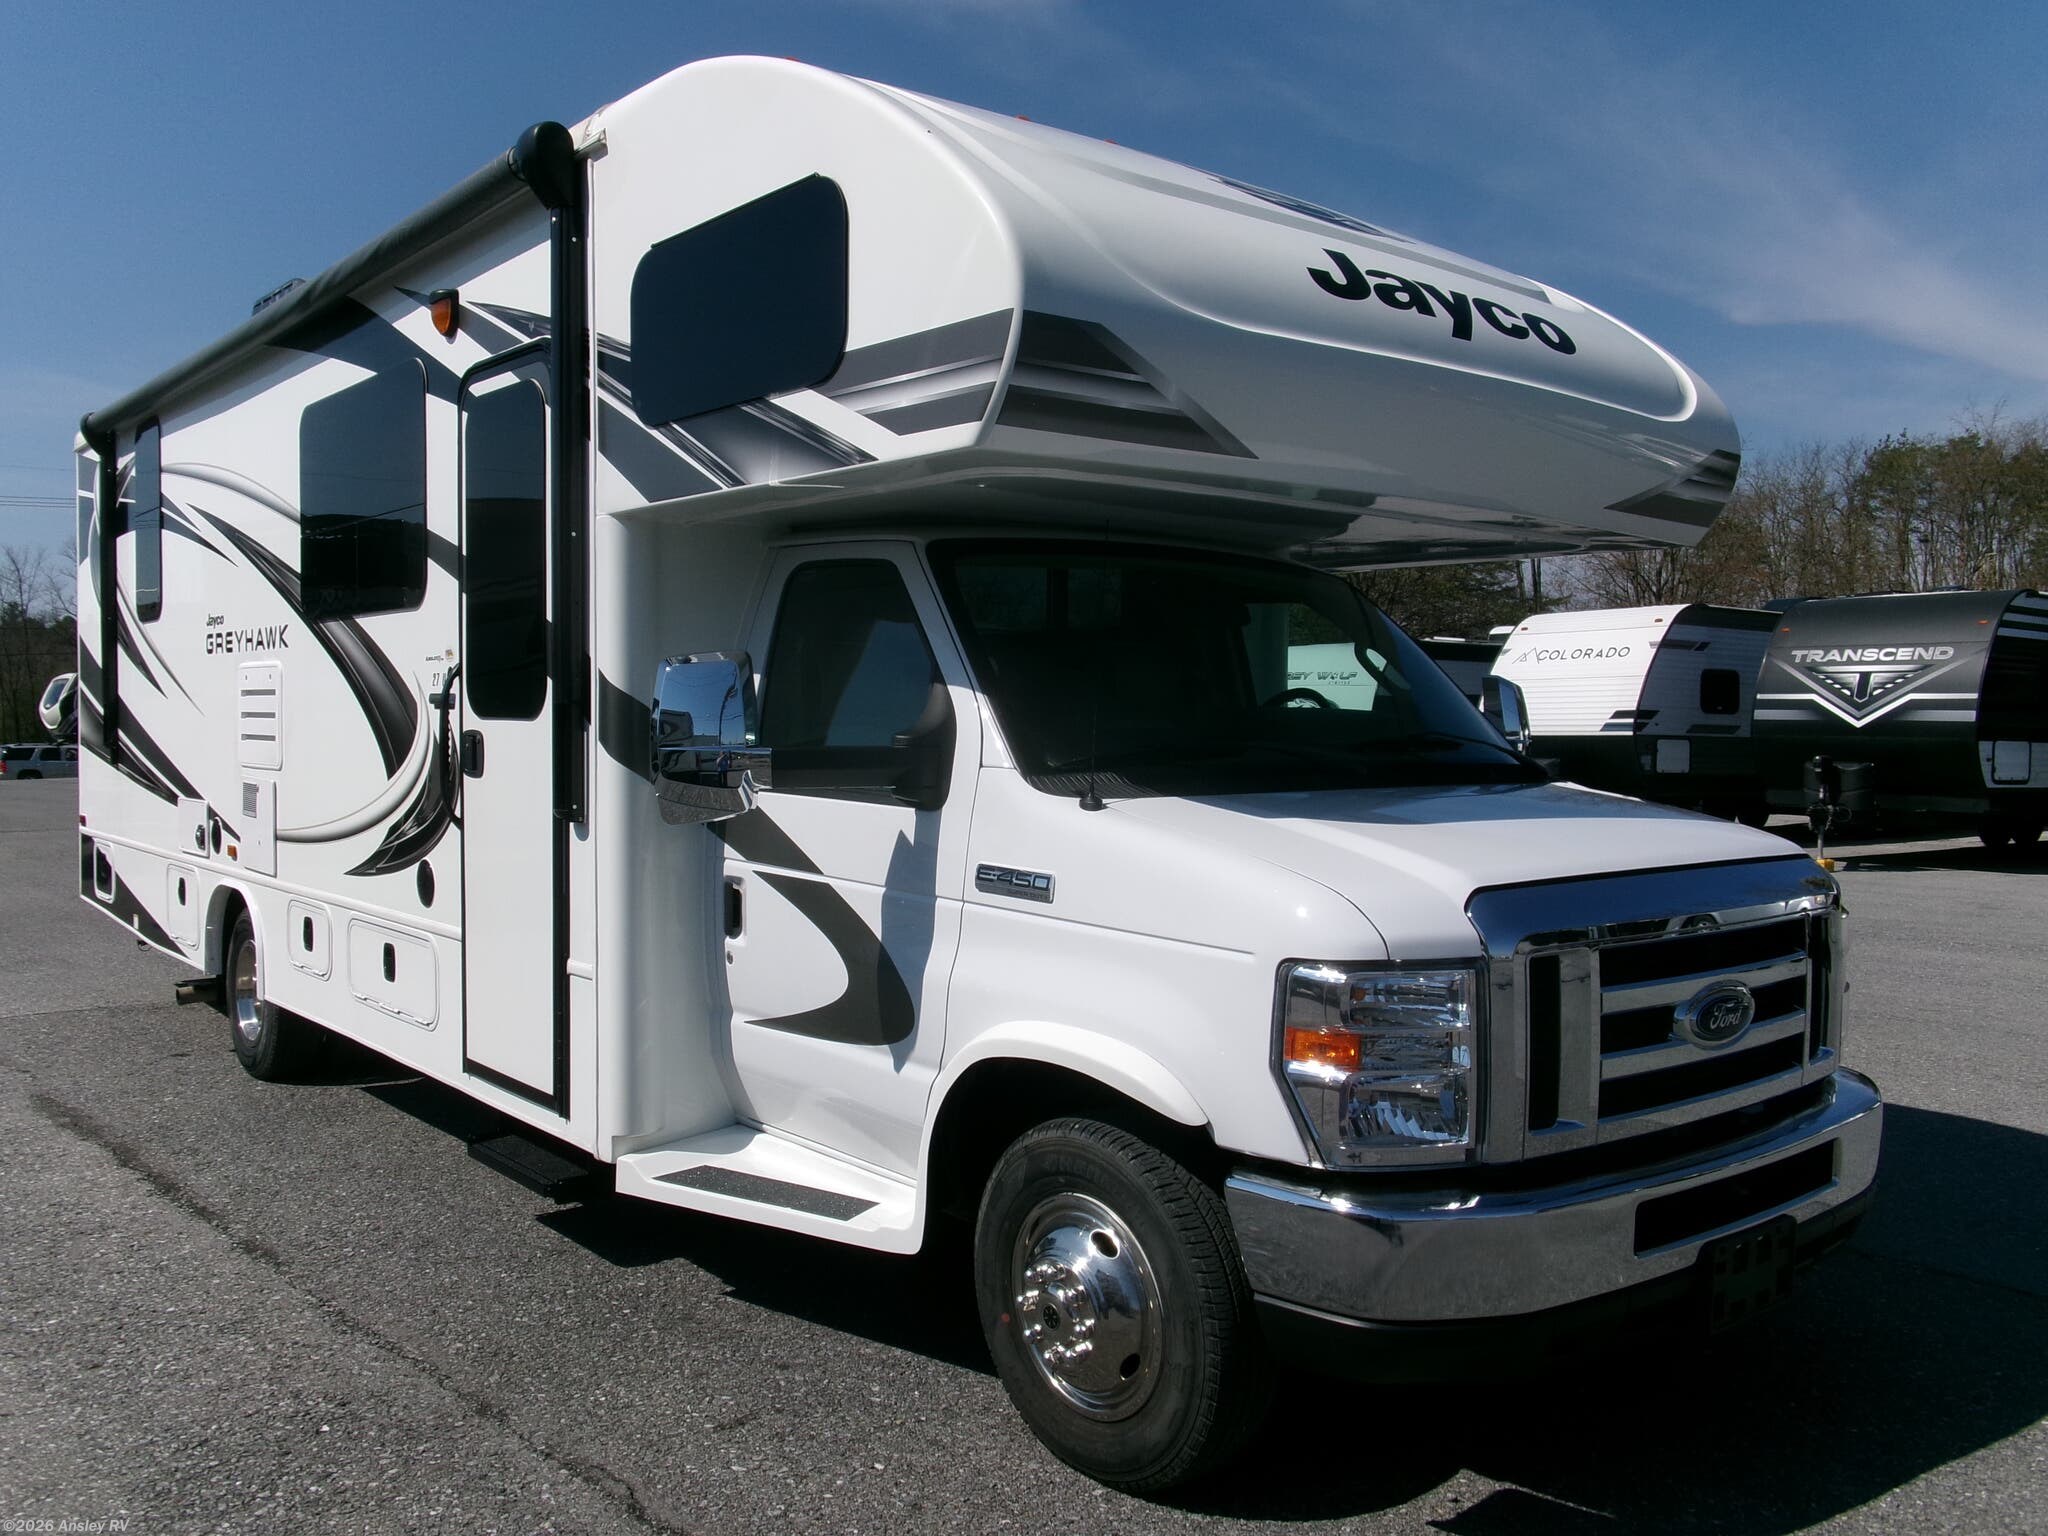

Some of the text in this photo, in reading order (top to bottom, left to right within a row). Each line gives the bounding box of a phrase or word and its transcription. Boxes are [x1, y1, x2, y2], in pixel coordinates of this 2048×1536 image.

[1306, 247, 1577, 355] Jayco
[206, 613, 225, 629] Jayco
[206, 624, 289, 655] GREYHAWK
[1538, 646, 1631, 661] COLORADO
[1791, 646, 1954, 663] TRANSCEND
[1710, 1002, 1744, 1030] Ford
